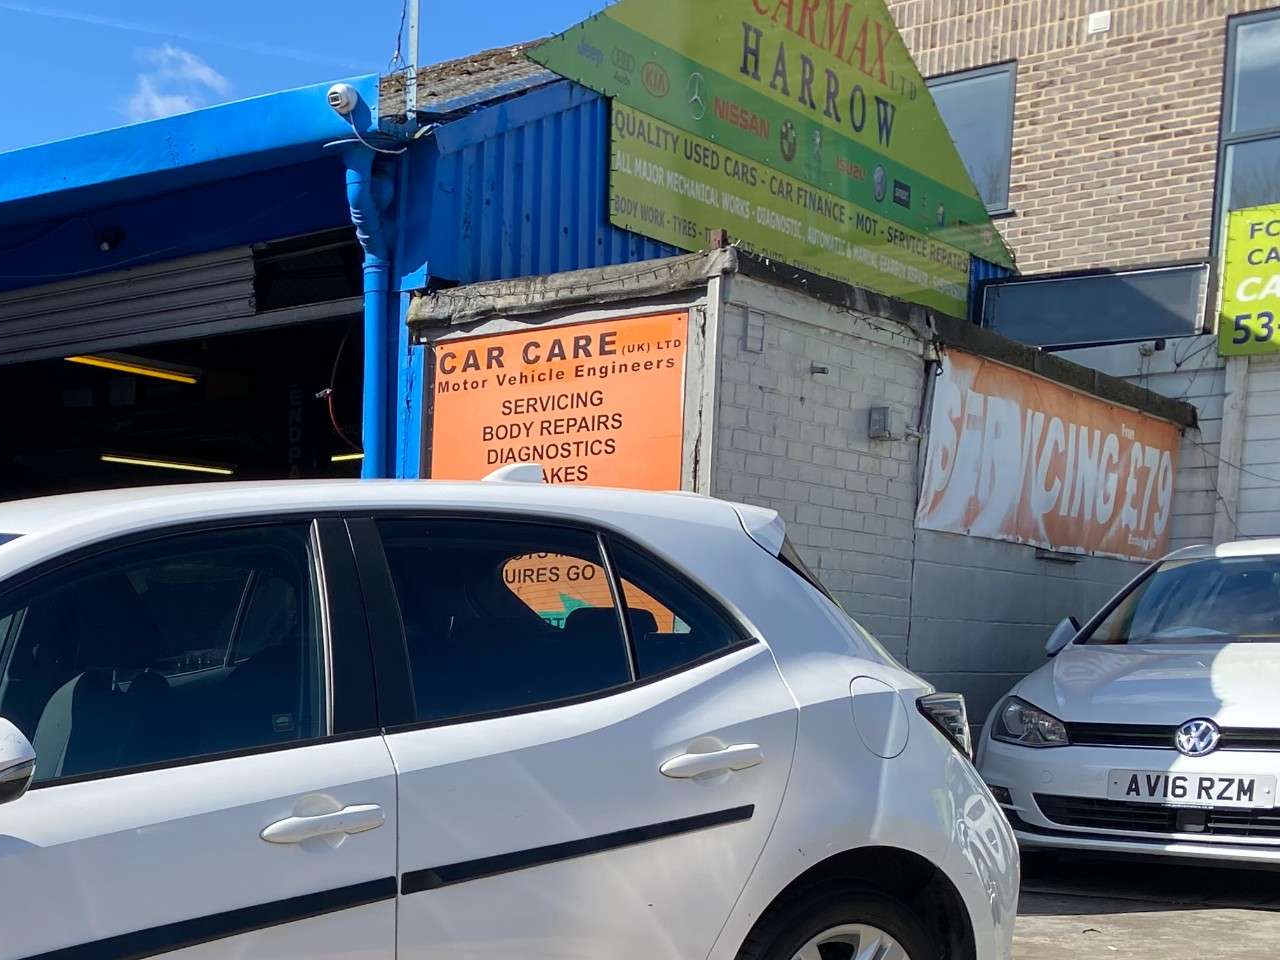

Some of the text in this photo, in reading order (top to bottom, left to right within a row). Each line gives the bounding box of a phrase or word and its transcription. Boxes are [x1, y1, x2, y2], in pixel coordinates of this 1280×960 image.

[752, 0, 894, 86] ARMAX
[739, 20, 896, 148] HARROW
[713, 95, 770, 139] NISSAN
[614, 109, 680, 154] QUALITY
[684, 138, 720, 170] USED
[724, 155, 757, 187] CARS
[769, 175, 793, 203] CAR
[796, 186, 846, 224] FINANCE
[855, 212, 878, 237] MOT
[887, 226, 928, 258] SERVICE
[615, 149, 632, 175] ALL
[634, 157, 665, 187] MAJOR
[666, 169, 720, 208] MECHANICAL
[721, 190, 750, 219] WORKS
[614, 194, 639, 217] BODY
[639, 203, 666, 227] WORK
[673, 215, 697, 238] TYRES
[1232, 311, 1280, 345] 53
[437, 356, 676, 394] Motor Vehicle Engineers
[439, 331, 682, 375] CAR CARE (UK) LTD
[501, 390, 605, 416] SERVICING
[482, 413, 623, 442] BODY REPAIRS
[487, 438, 617, 465] DIAGNOSTICS
[1122, 441, 1173, 536] £79
[566, 564, 596, 581] GO
[1126, 773, 1256, 802] AV16 RZM
